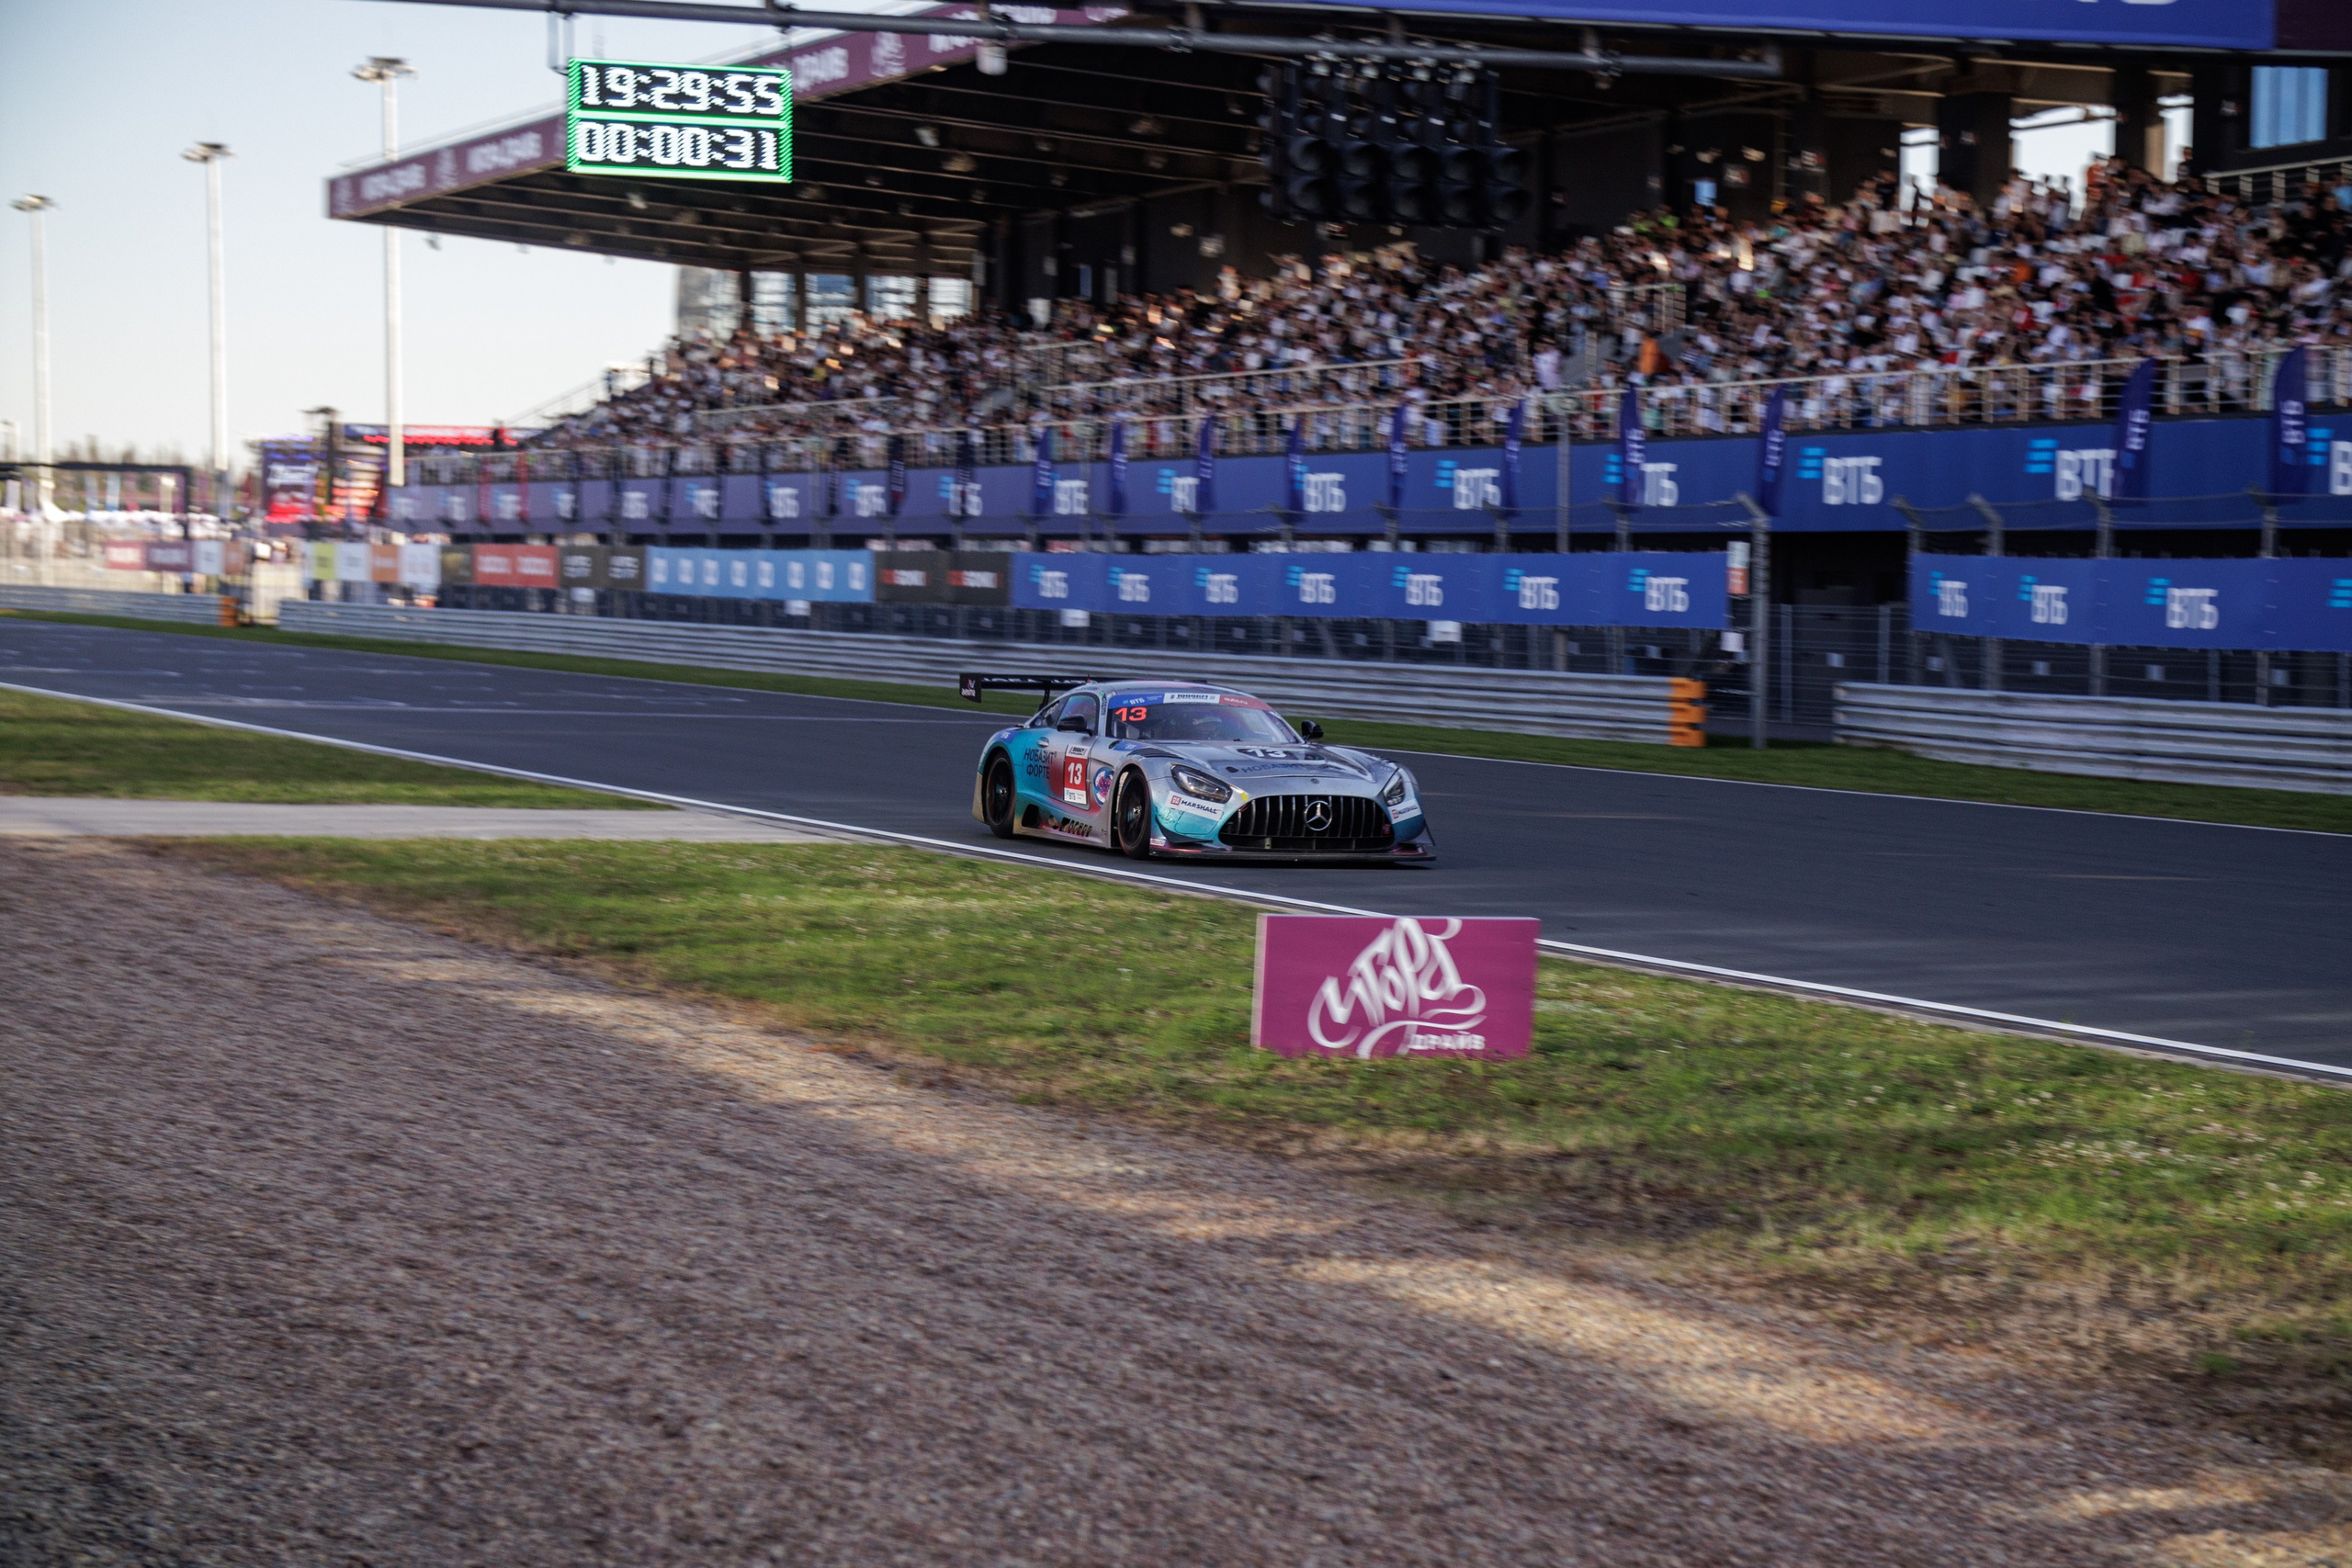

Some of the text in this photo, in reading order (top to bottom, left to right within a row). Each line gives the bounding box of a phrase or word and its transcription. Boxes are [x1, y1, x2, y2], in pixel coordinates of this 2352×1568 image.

[580, 64, 784, 115] 19:29:55
[575, 120, 780, 170] 00:00:31
[1640, 462, 1679, 506] ТБ
[1822, 456, 1883, 505] ВТБ
[2166, 588, 2219, 629] ВТБ
[1130, 697, 1145, 705] ВТБ
[1114, 706, 1148, 722] 13
[1247, 749, 1287, 758] 13
[1026, 764, 1050, 779] ФОРТЕ
[1068, 762, 1083, 785] 13
[1181, 800, 1218, 815] MARSHALL
